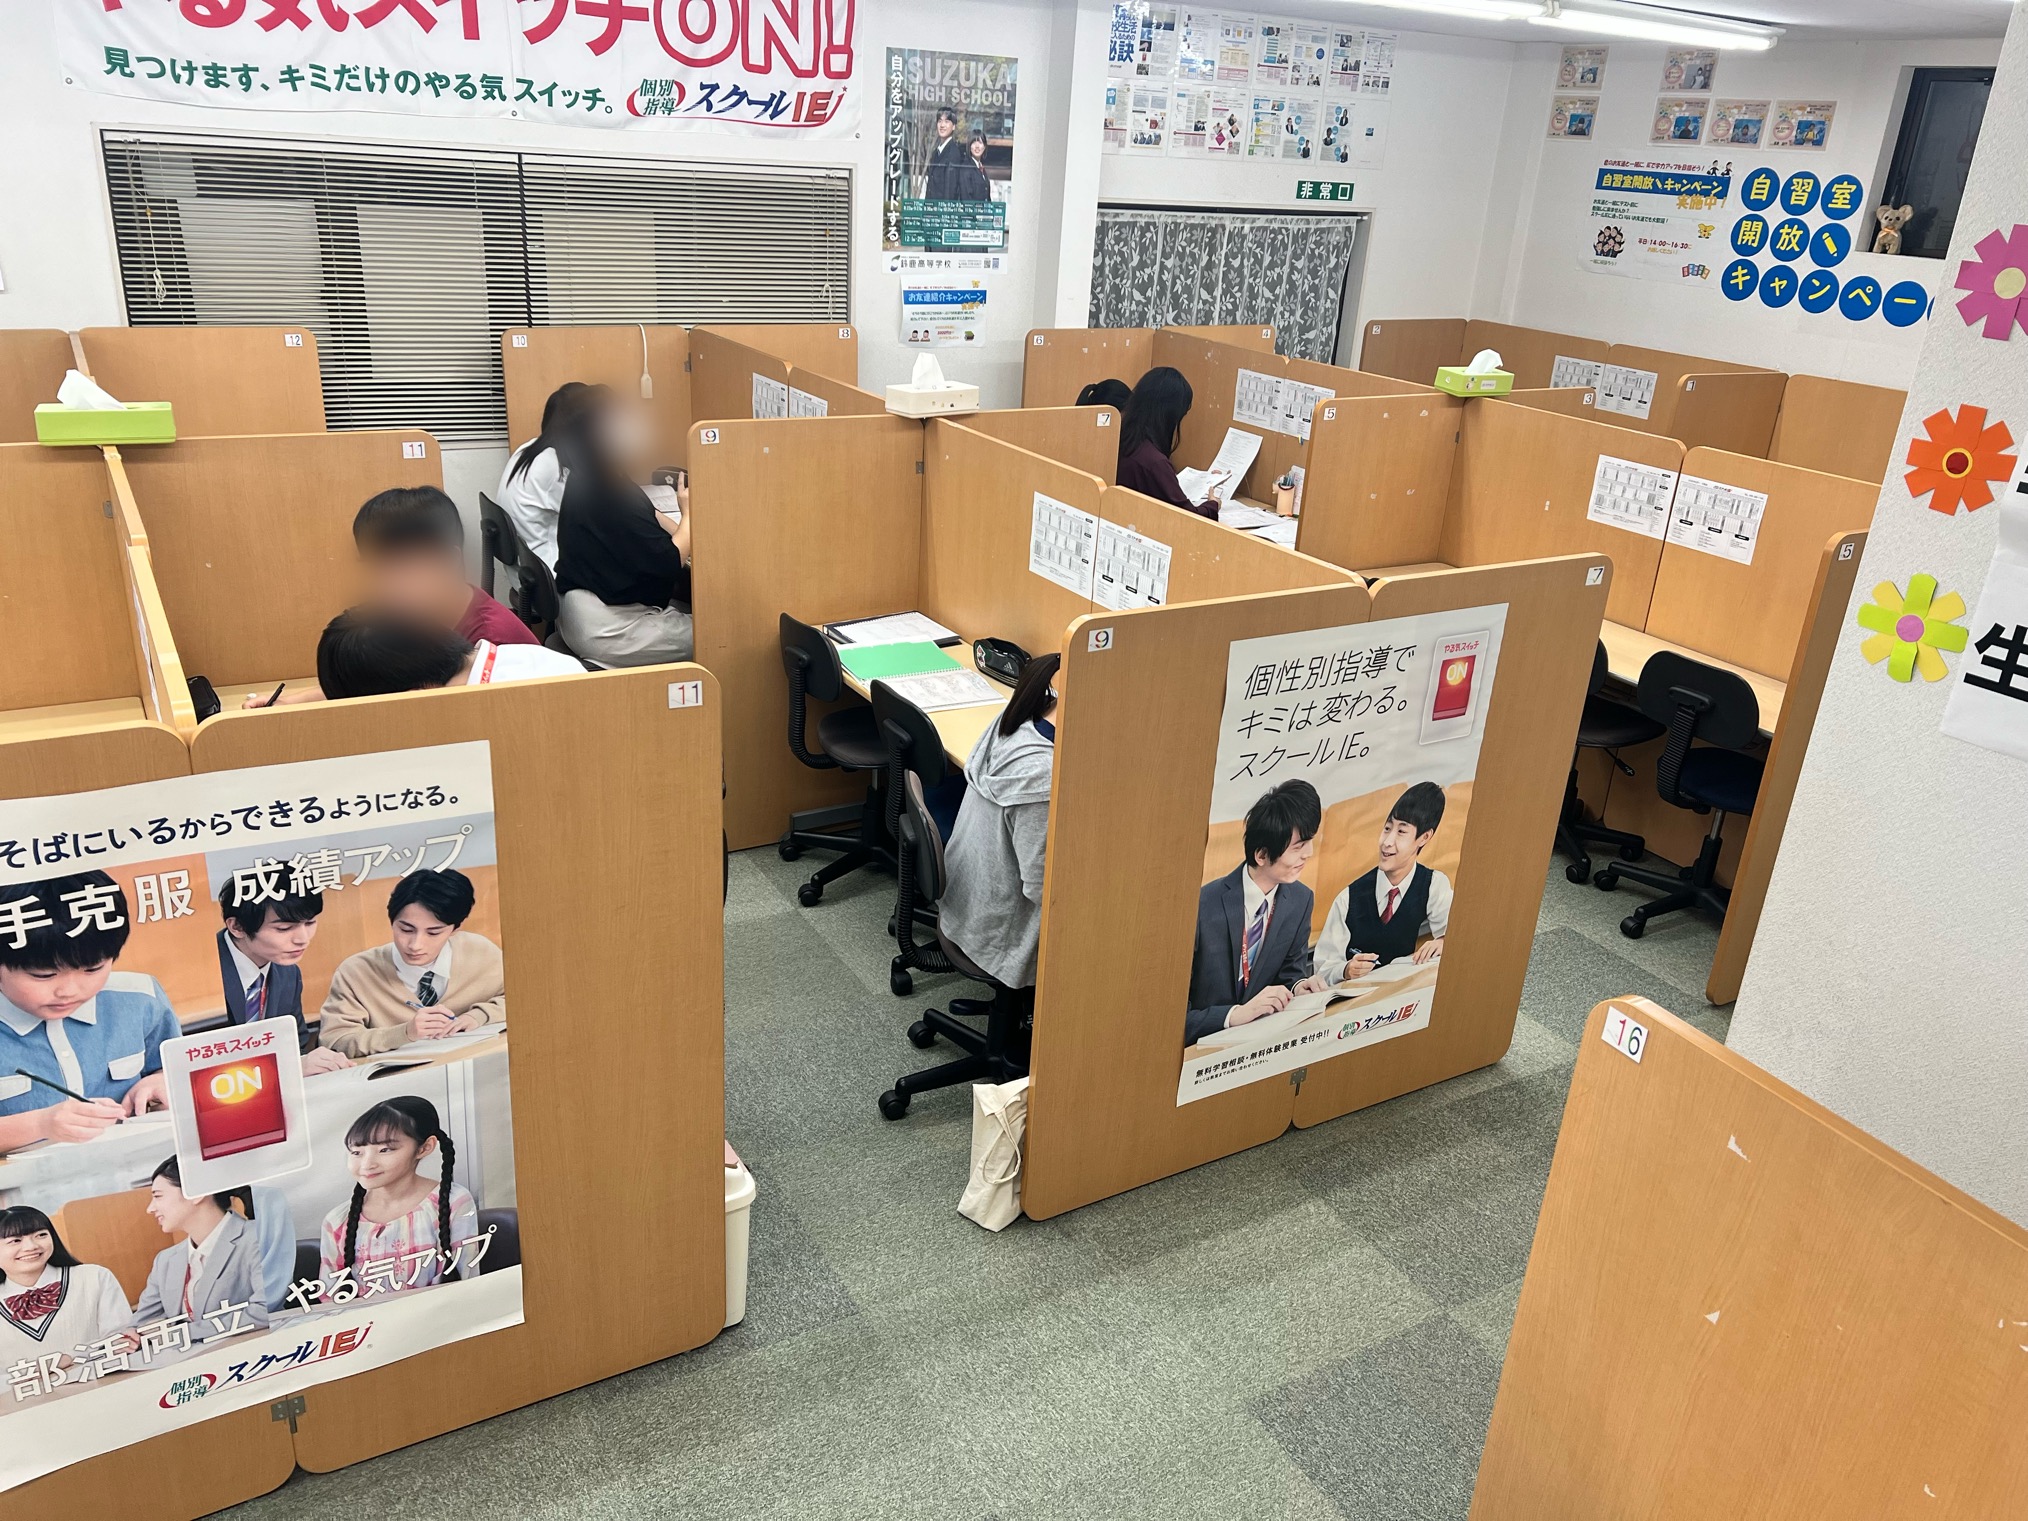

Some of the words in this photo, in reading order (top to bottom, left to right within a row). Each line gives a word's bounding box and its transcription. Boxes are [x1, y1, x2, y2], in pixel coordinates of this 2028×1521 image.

[907, 56, 1012, 91] SUZUKA
[639, 78, 676, 98] 個別
[908, 84, 946, 103] HIGH
[951, 88, 1012, 107] SCHOOL
[643, 97, 678, 116] 指導
[887, 55, 903, 247] 自分をアップグレードする。
[1300, 181, 1351, 200] 非常口
[1601, 173, 1656, 190] 自習室開放
[1663, 178, 1723, 195] キャンペーン
[1750, 173, 1857, 209] 自習室
[1736, 219, 1804, 252] 開放
[908, 292, 984, 303] お友達紹介キャンペーン
[289, 335, 301, 346] 12
[516, 336, 526, 346] 10
[842, 328, 850, 338] 8
[1035, 335, 1043, 345] 6
[1263, 329, 1270, 338] 4
[1585, 394, 1592, 404] 3
[1101, 414, 1110, 425] 7
[1325, 408, 1335, 420] 5
[704, 430, 717, 443] 9
[408, 443, 424, 457] 11
[1841, 544, 1853, 559] 5
[1593, 567, 1604, 583] 7
[1095, 630, 1109, 649] 9
[1444, 640, 1480, 653] やる気スイッチ
[1244, 644, 1417, 701] 個性別指導で
[1446, 661, 1469, 681] ON
[678, 683, 699, 705] 11
[1237, 685, 1408, 739] キミは変わる。
[0, 785, 459, 868] そばにいるからできるようになる。
[231, 824, 474, 907] 成績アップ
[185, 1031, 275, 1062] やる気スイッチ
[1617, 1018, 1643, 1056] 16
[210, 1065, 263, 1099] ON
[285, 1223, 497, 1314] やる気アップ
[7, 1299, 255, 1402] 部活両立
[170, 1374, 202, 1396] 個別
[176, 1385, 208, 1406] 指導
